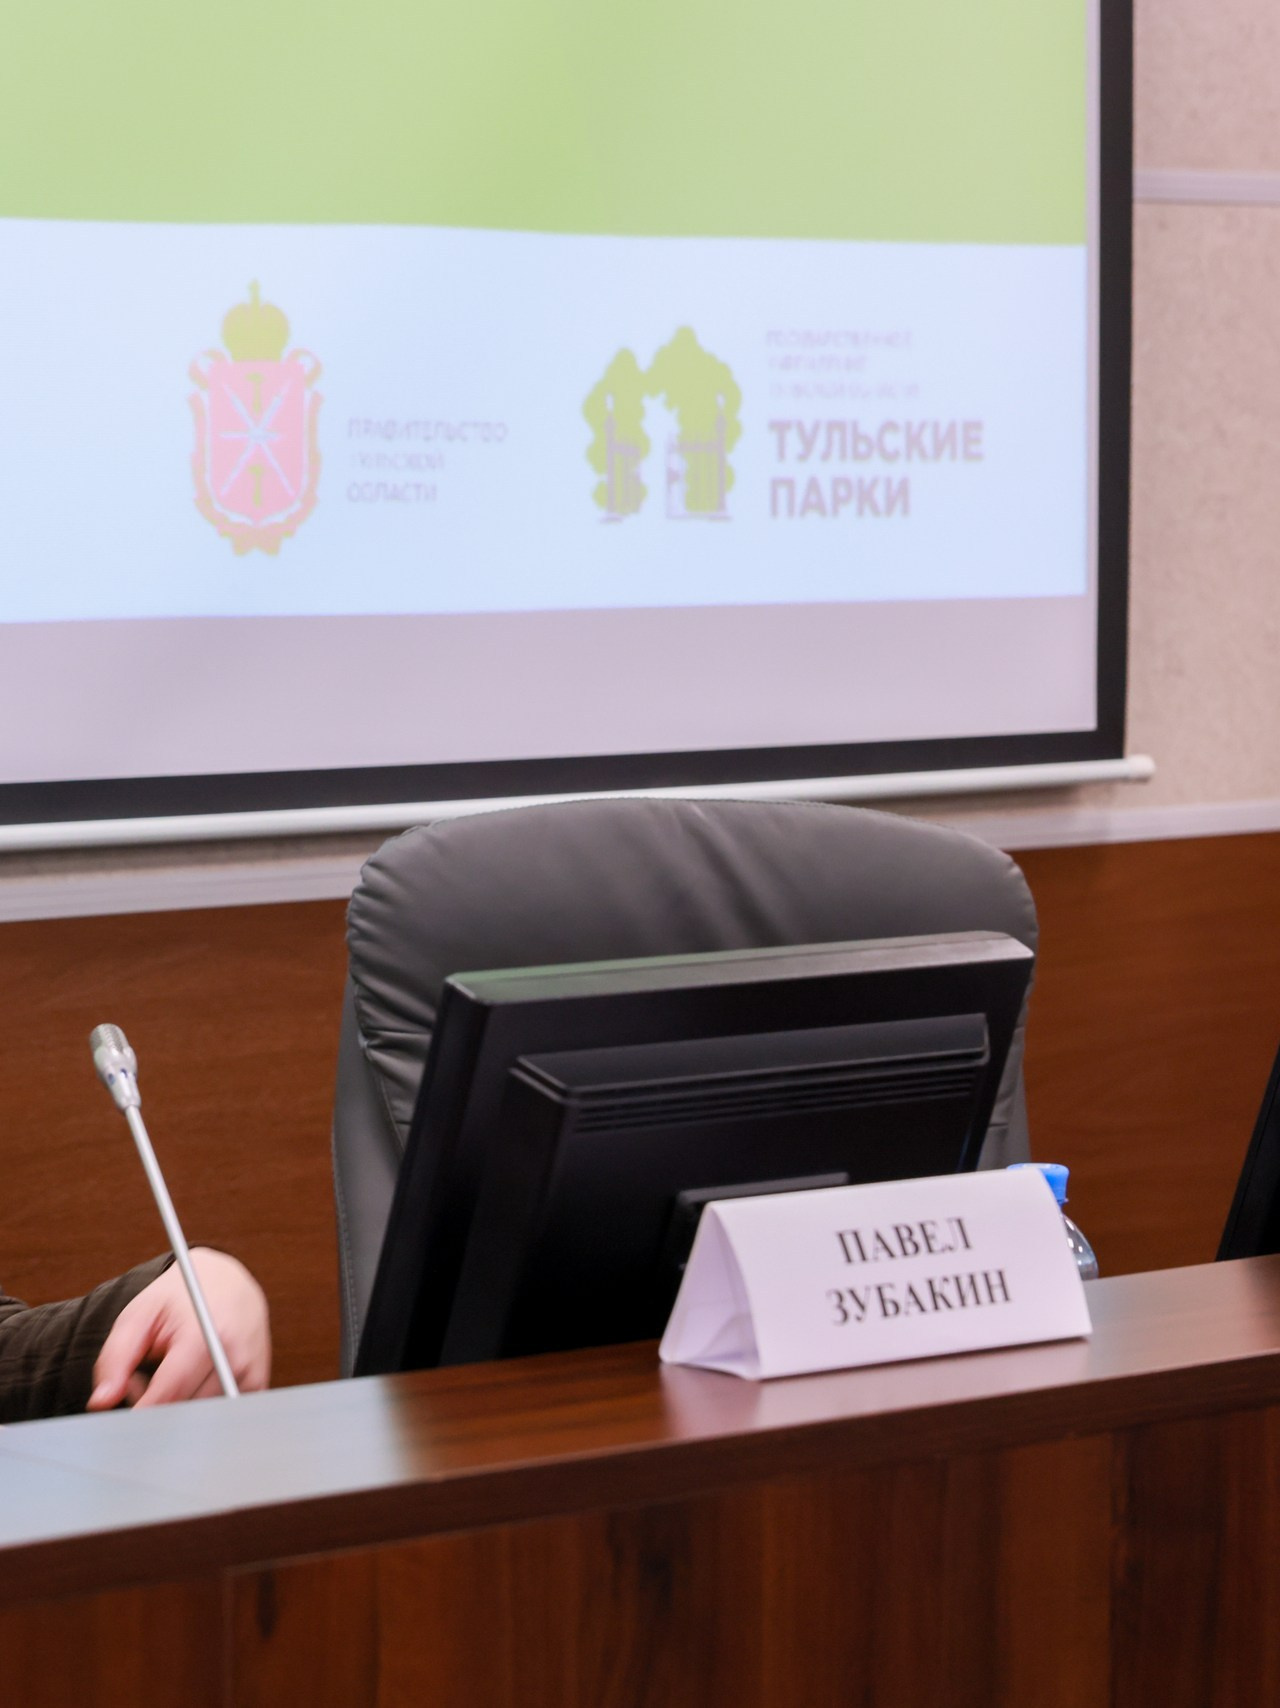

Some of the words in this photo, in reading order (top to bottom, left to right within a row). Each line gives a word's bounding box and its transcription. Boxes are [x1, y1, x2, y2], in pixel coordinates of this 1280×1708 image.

[768, 418, 985, 462] ТУЛЬСКИЕ
[769, 475, 910, 518] ПАРКИ
[835, 1217, 973, 1265] ПАВЕЛ
[826, 1268, 1012, 1326] ЗУБАКИН
